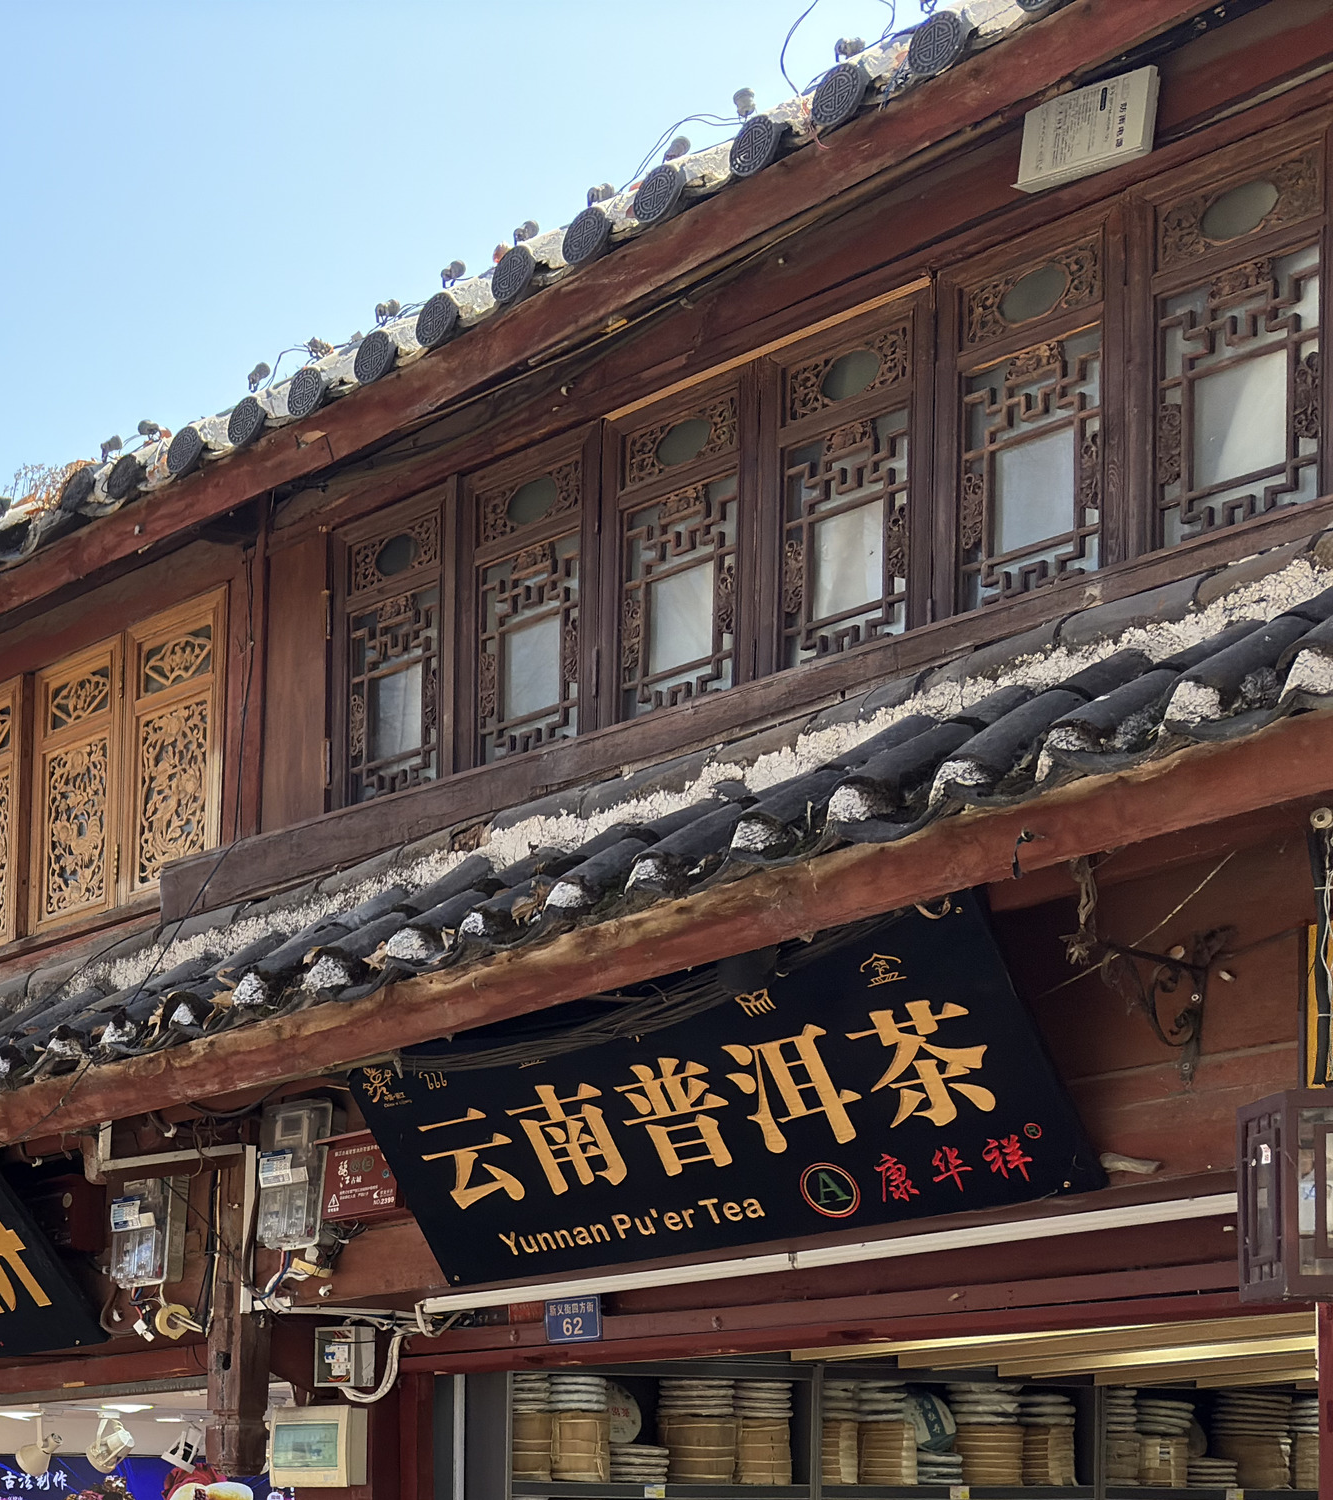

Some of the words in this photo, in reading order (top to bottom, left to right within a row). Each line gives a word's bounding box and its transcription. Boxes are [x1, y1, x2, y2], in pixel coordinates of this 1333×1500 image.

[418, 1000, 995, 1211] 云南普洱茶
[873, 1134, 1033, 1203] 康华祥
[498, 1222, 611, 1256] Yunnan
[611, 1208, 695, 1239] Pu'er
[698, 1197, 766, 1225] Tea
[549, 1301, 594, 1317] 新义街四方街
[562, 1317, 583, 1336] 62
[1, 1469, 68, 1491] 古法制作
